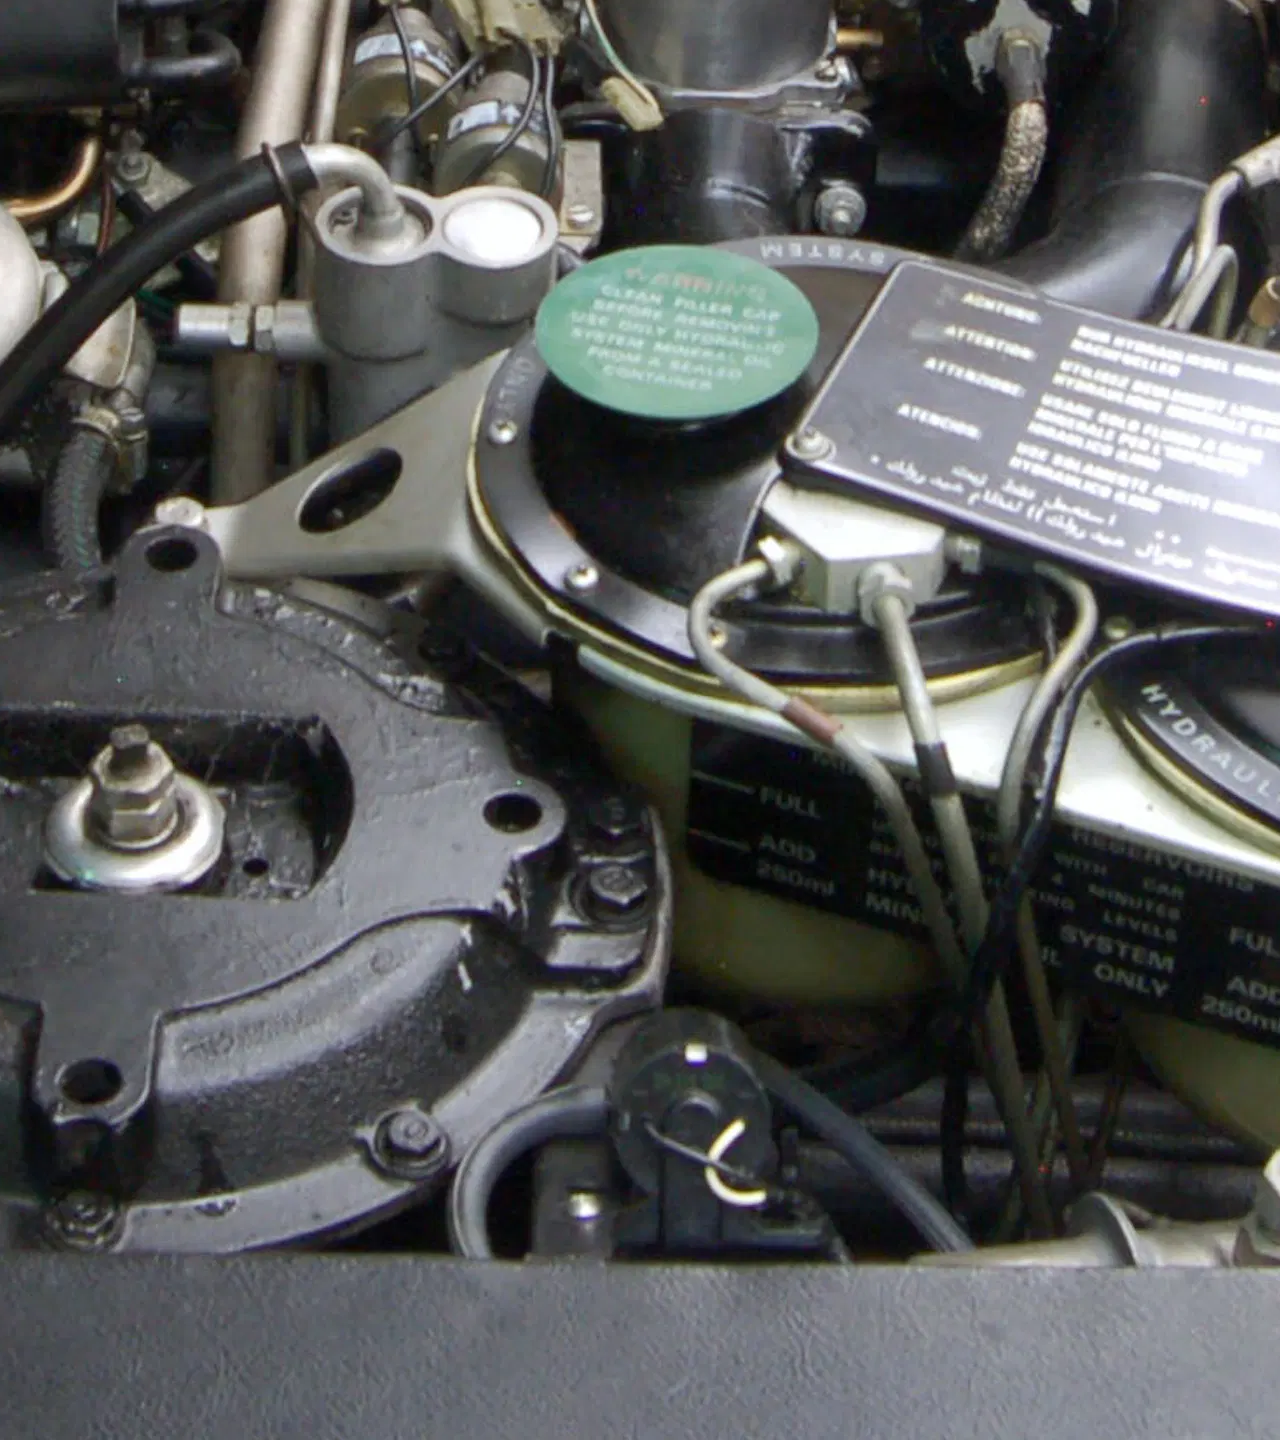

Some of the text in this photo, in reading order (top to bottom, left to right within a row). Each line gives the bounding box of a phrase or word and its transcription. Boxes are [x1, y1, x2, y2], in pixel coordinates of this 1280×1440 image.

[592, 298, 664, 322] BEFORE
[600, 284, 664, 306] CLEAN
[570, 310, 610, 328] USE
[618, 319, 667, 337] ONLY
[570, 327, 645, 350] SYSTEM
[587, 344, 642, 363] FROM
[602, 363, 713, 392] CONTAINER
[760, 787, 822, 820] FULL
[760, 834, 816, 861] ADD
[1072, 828, 1255, 892] RESERVOIRS
[1053, 851, 1184, 901] WITH CAR
[1088, 883, 1181, 921] MINUTES
[1104, 909, 1178, 944] LEVELS
[1061, 922, 1175, 974] SYSTEM
[1094, 962, 1168, 999] ONLY
